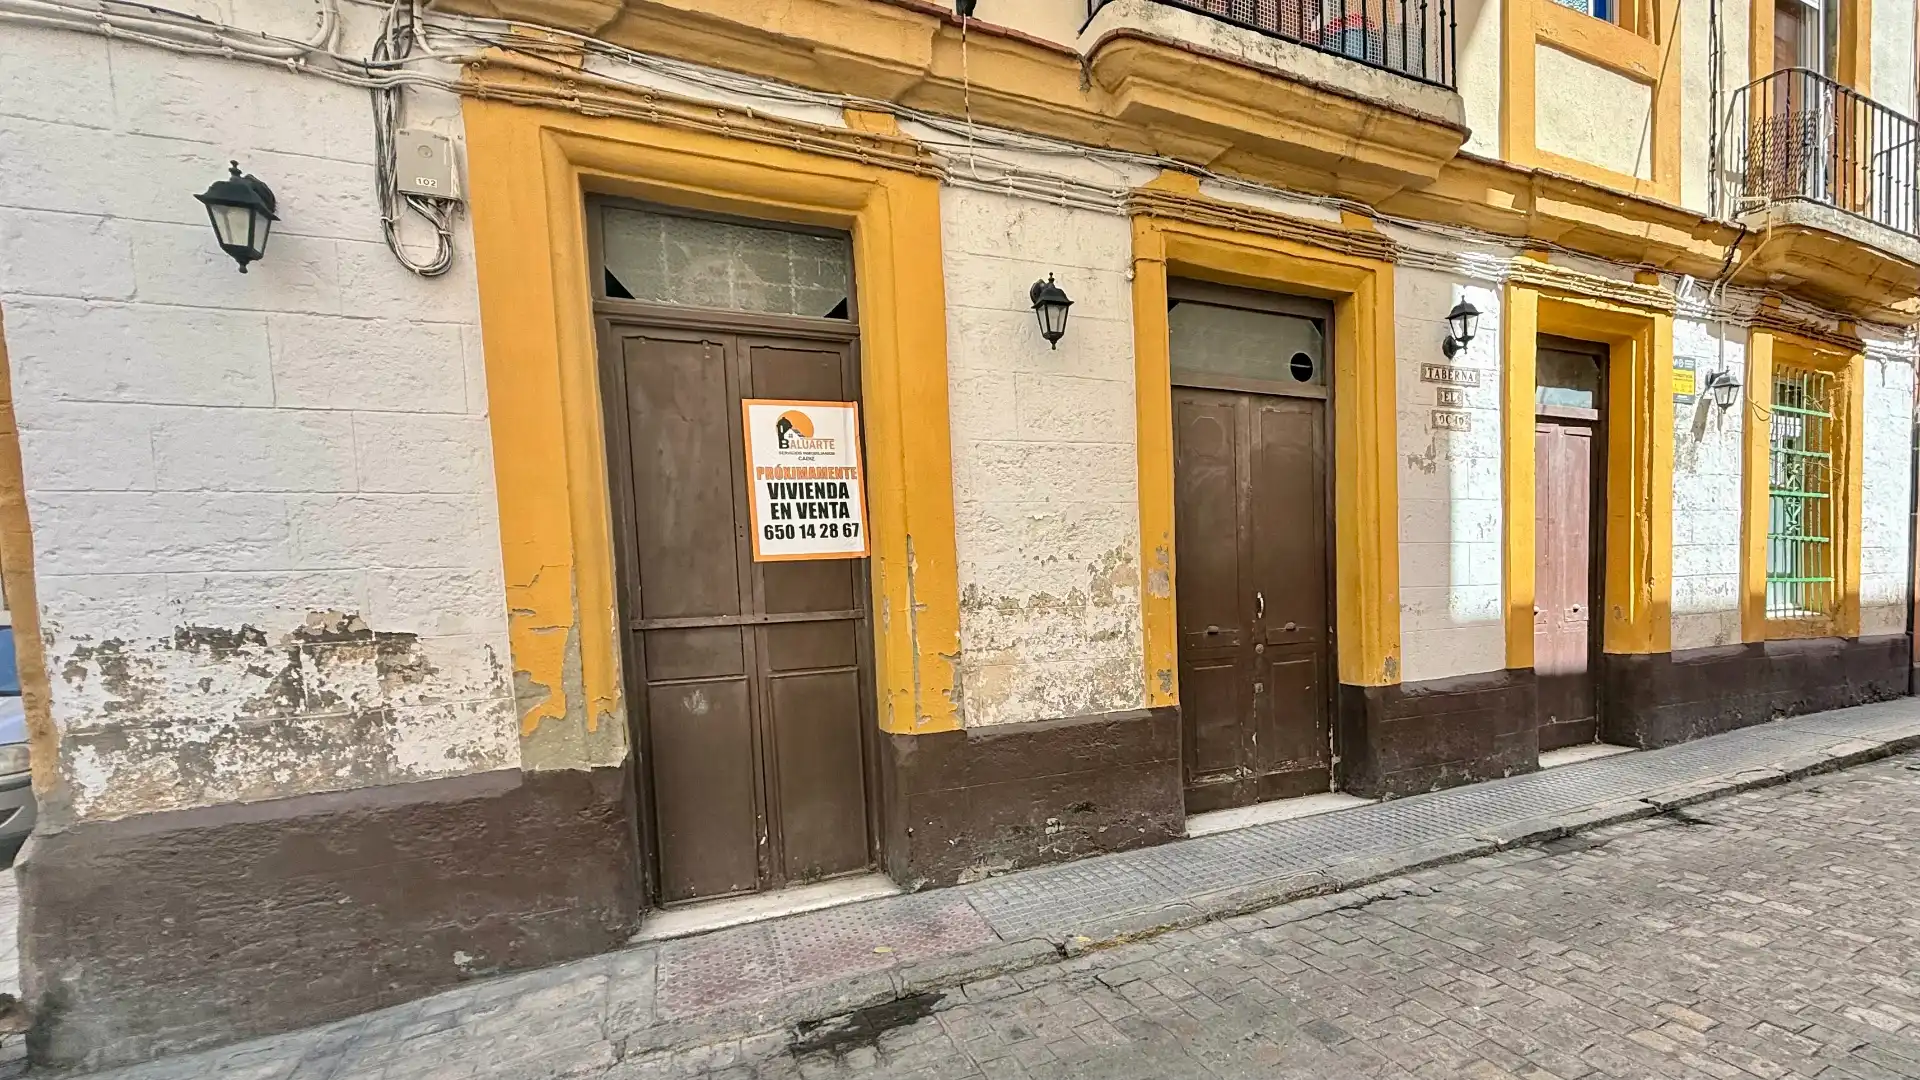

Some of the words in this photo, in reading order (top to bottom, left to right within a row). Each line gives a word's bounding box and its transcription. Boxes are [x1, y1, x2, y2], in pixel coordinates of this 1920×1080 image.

[418, 178, 437, 187] 102
[1427, 368, 1474, 382] TABERNA
[1444, 391, 1457, 402] EL
[778, 439, 836, 450] BALUARTE
[756, 464, 858, 480] PRÓXIMAMENTE
[767, 482, 850, 500] VIVIENDA
[770, 502, 792, 520] EN
[796, 501, 850, 519] VENTA
[764, 524, 795, 540] 650
[799, 523, 816, 539] 14
[819, 523, 839, 539] 28
[842, 522, 860, 538] 67
